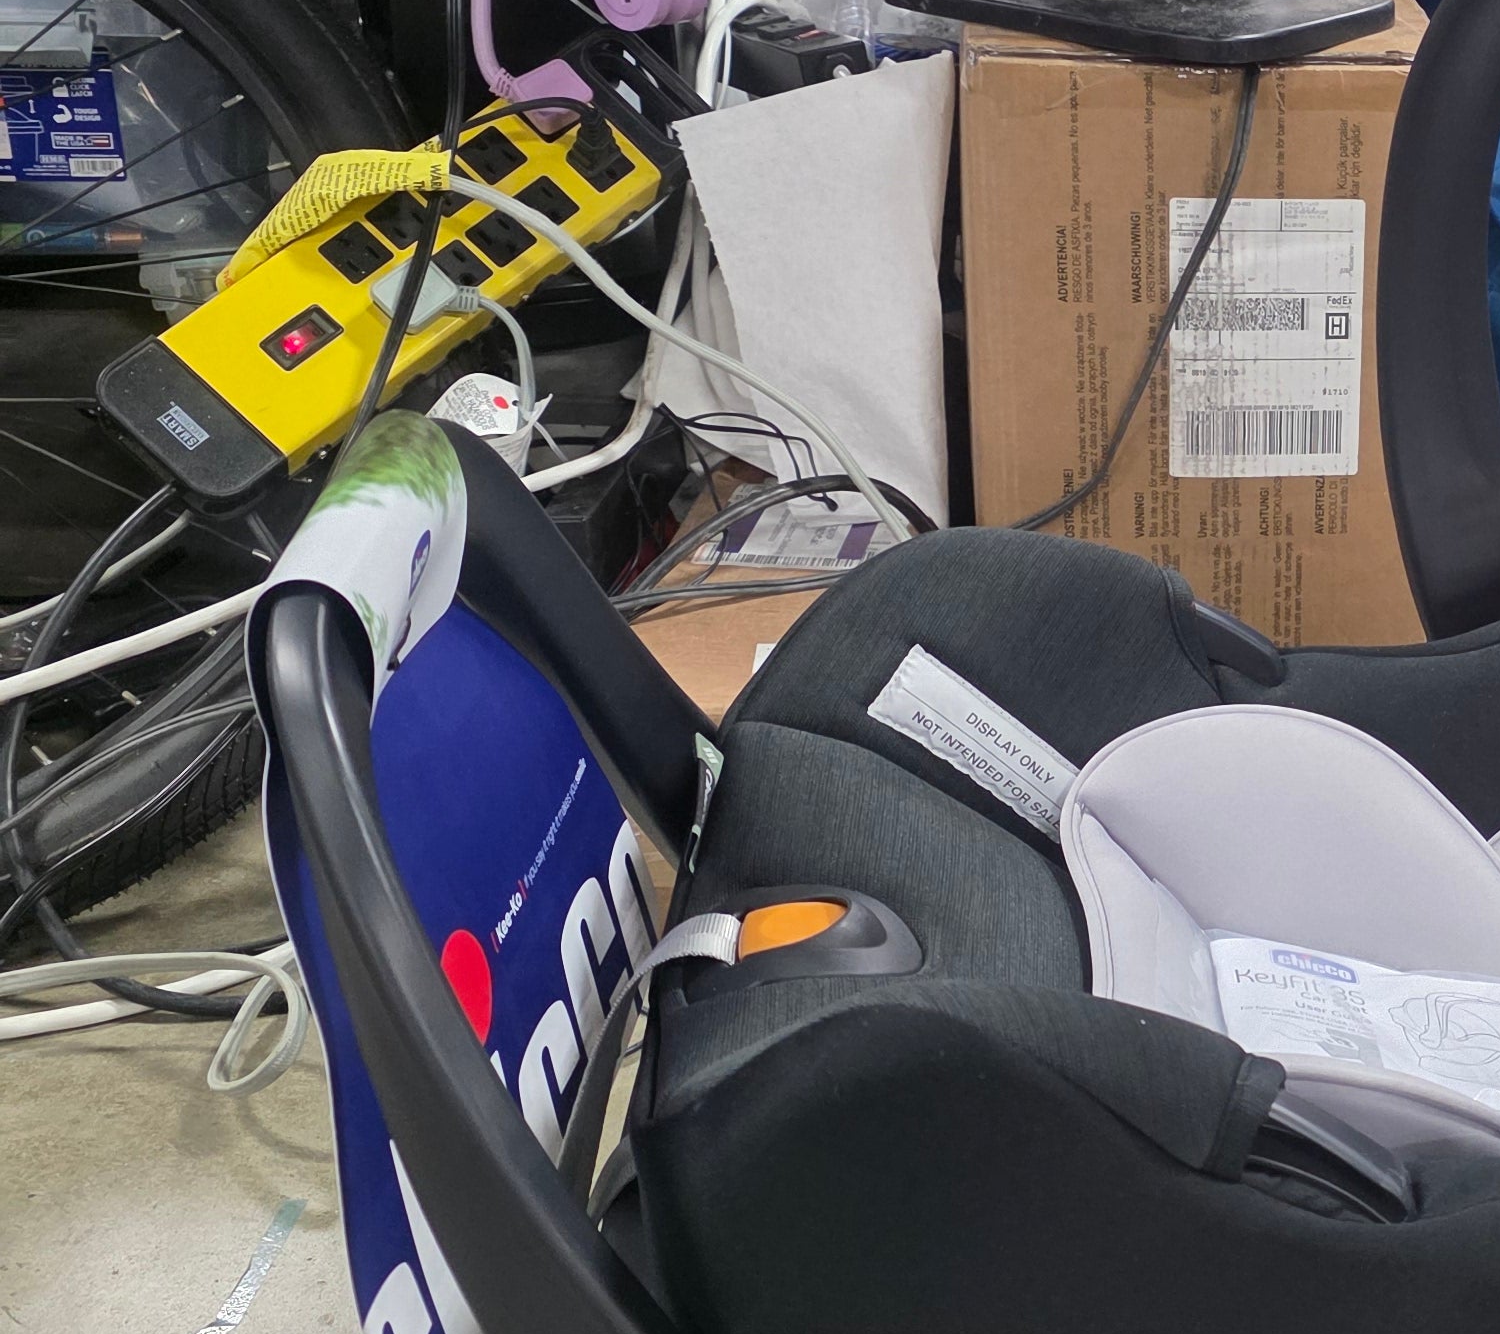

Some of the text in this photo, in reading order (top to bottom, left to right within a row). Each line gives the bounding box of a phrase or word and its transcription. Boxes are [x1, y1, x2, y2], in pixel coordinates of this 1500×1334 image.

[1337, 115, 1350, 158] parçalar.
[1349, 121, 1364, 158] değildir.
[1056, 224, 1068, 303] ADVERTENCIA!
[1071, 253, 1082, 303] RIESGO DE
[1130, 210, 1142, 303] WAARSCHUWING!
[1326, 296, 1353, 305] FedEx
[1331, 320, 1343, 335] H
[162, 415, 198, 446] SMART
[1134, 491, 1146, 538] VARNING!
[1259, 487, 1270, 537] ACHTUNG!
[965, 712, 1055, 785] DISPLAY ONLY
[912, 710, 1061, 831] NOT INTENDED FOR SALE
[494, 891, 522, 944] Kee-Ko
[528, 860, 538, 885] you
[535, 850, 546, 867] say
[545, 822, 558, 846] right
[558, 794, 572, 820] makes
[569, 780, 579, 801] you
[1234, 969, 1365, 1006] KeyFit 35
[1277, 953, 1352, 980] chicco
[1295, 1001, 1326, 1013] User
[1300, 992, 1326, 1003] Car
